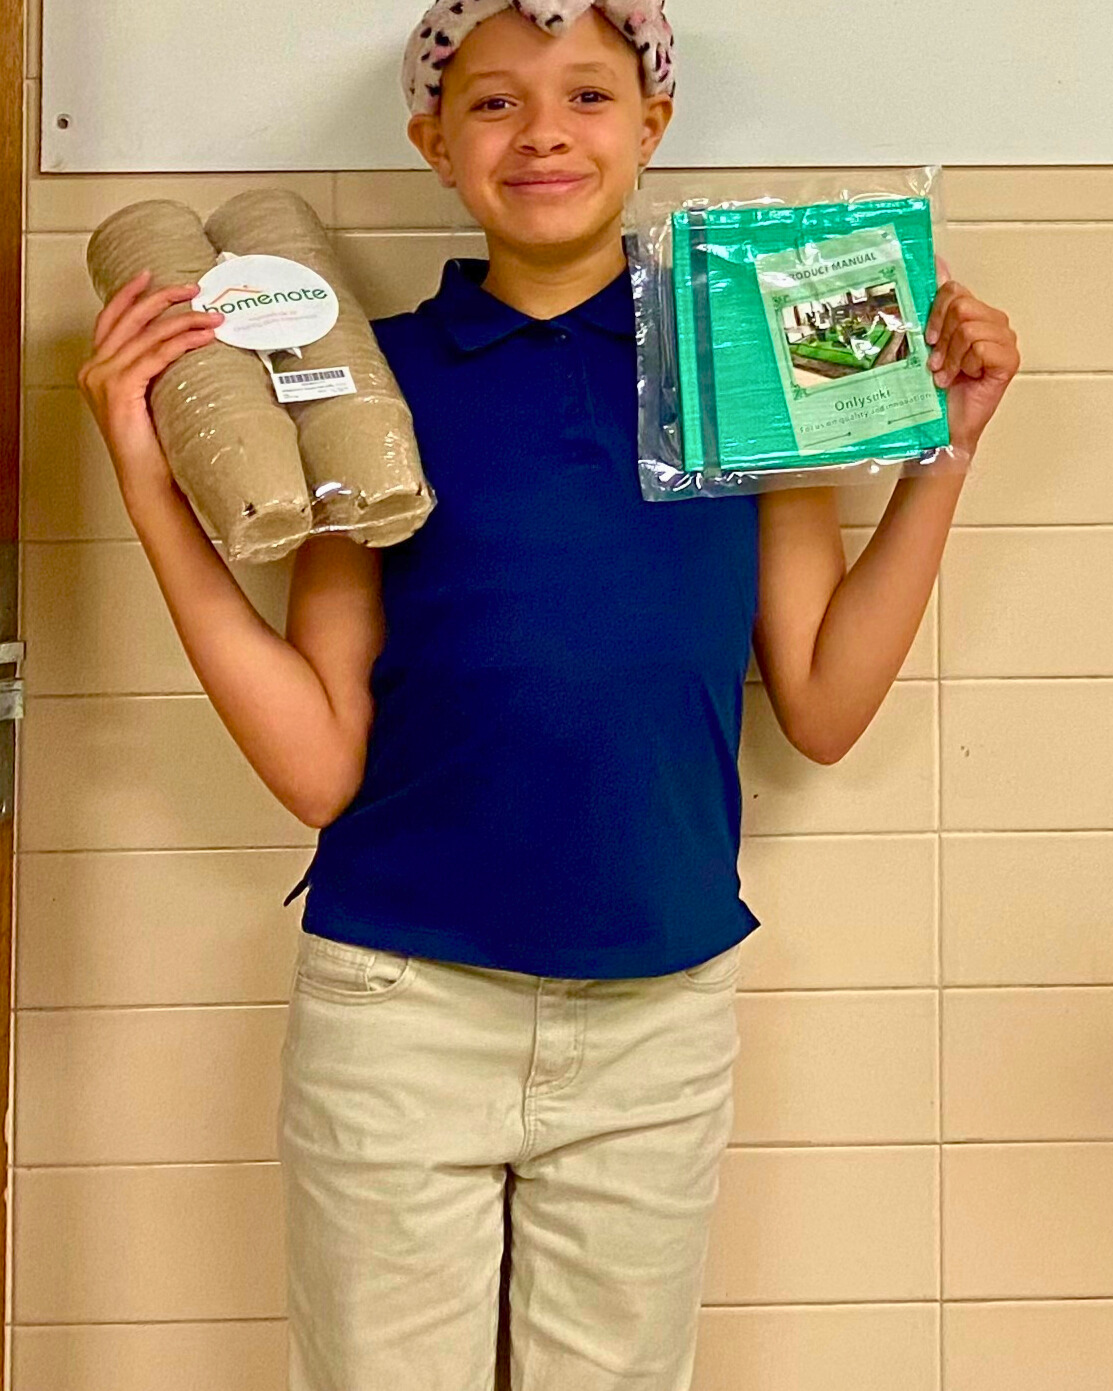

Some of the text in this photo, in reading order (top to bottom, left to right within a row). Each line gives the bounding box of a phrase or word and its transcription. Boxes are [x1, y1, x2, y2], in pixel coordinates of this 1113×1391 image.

[788, 252, 877, 281] RODUCT MANUAL
[202, 288, 328, 314] homenote
